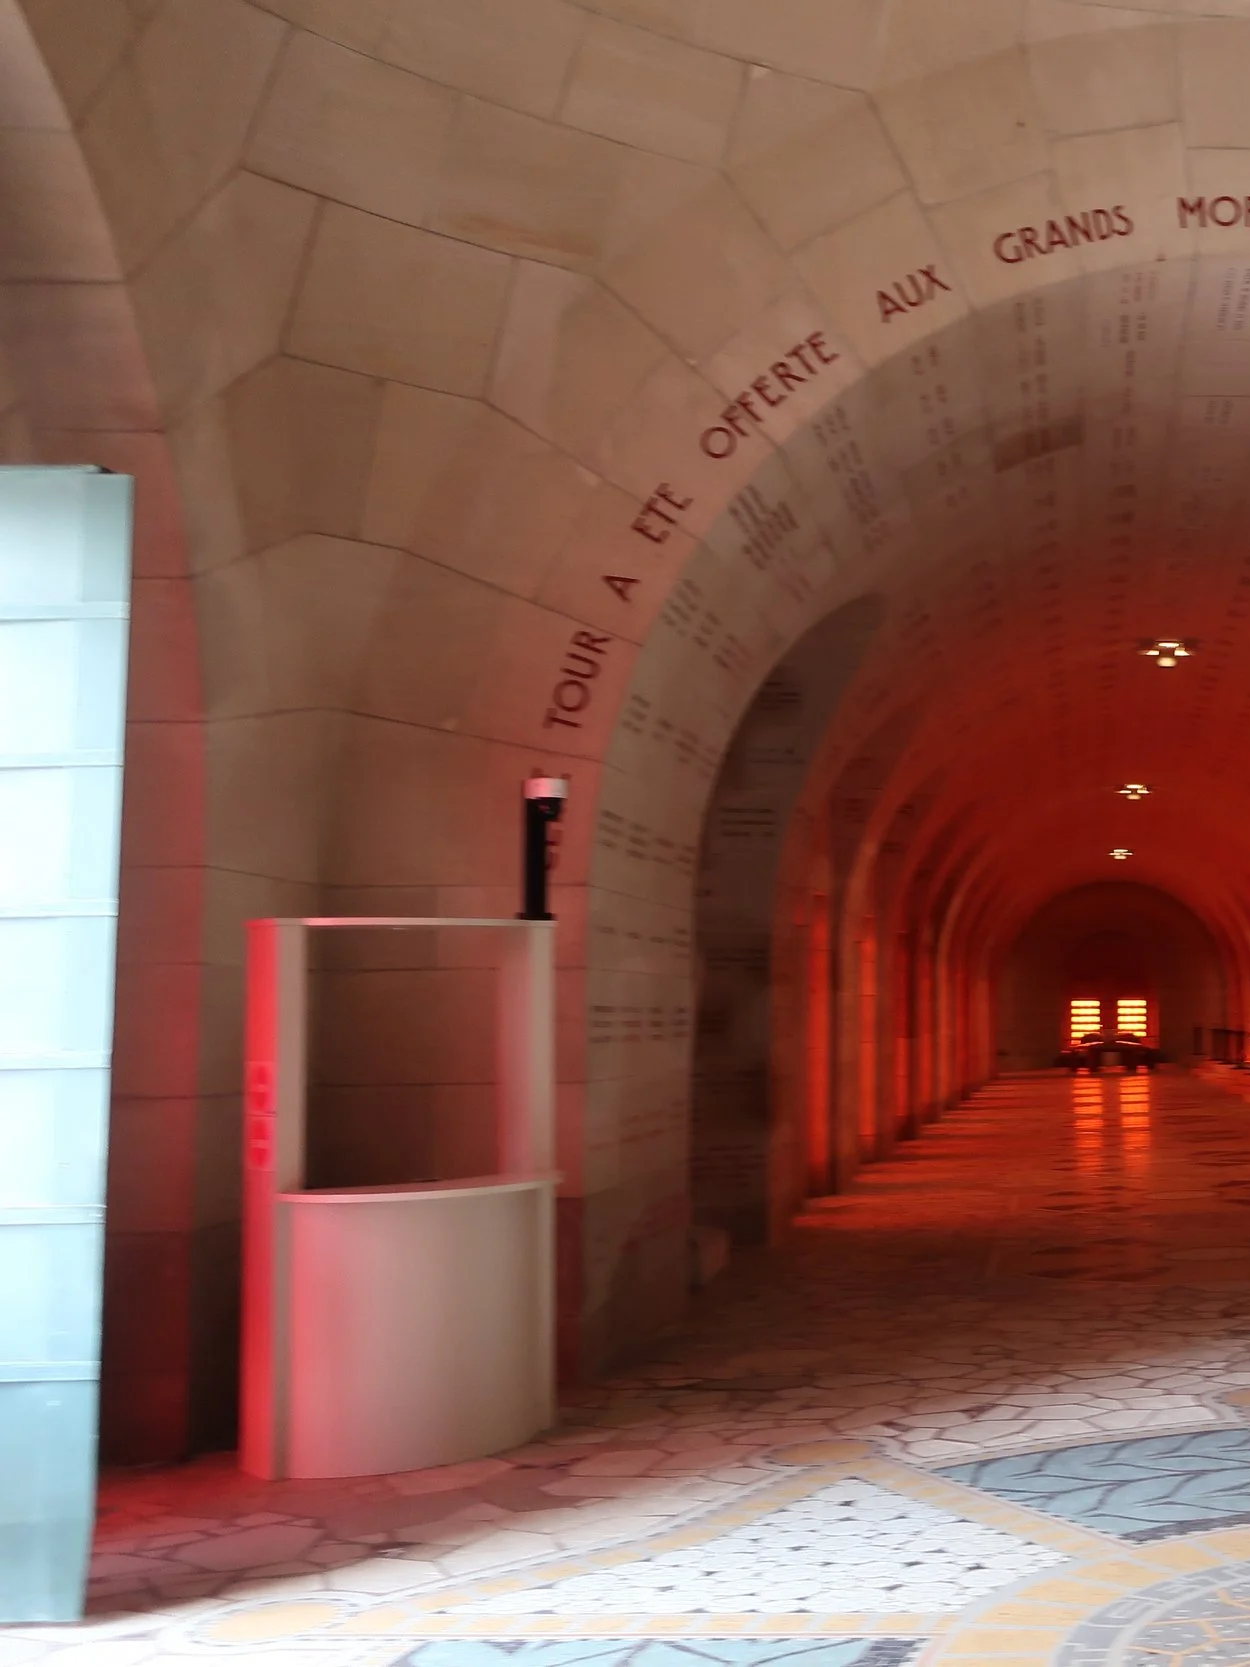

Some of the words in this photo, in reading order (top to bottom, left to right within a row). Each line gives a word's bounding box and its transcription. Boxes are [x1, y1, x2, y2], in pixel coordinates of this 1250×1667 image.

[545, 629, 612, 729] TOUR
[603, 572, 640, 603] A
[632, 482, 694, 544] ETE
[700, 331, 839, 460] OFFERTE
[876, 264, 951, 323] AUX
[994, 204, 1134, 265] GRANDS
